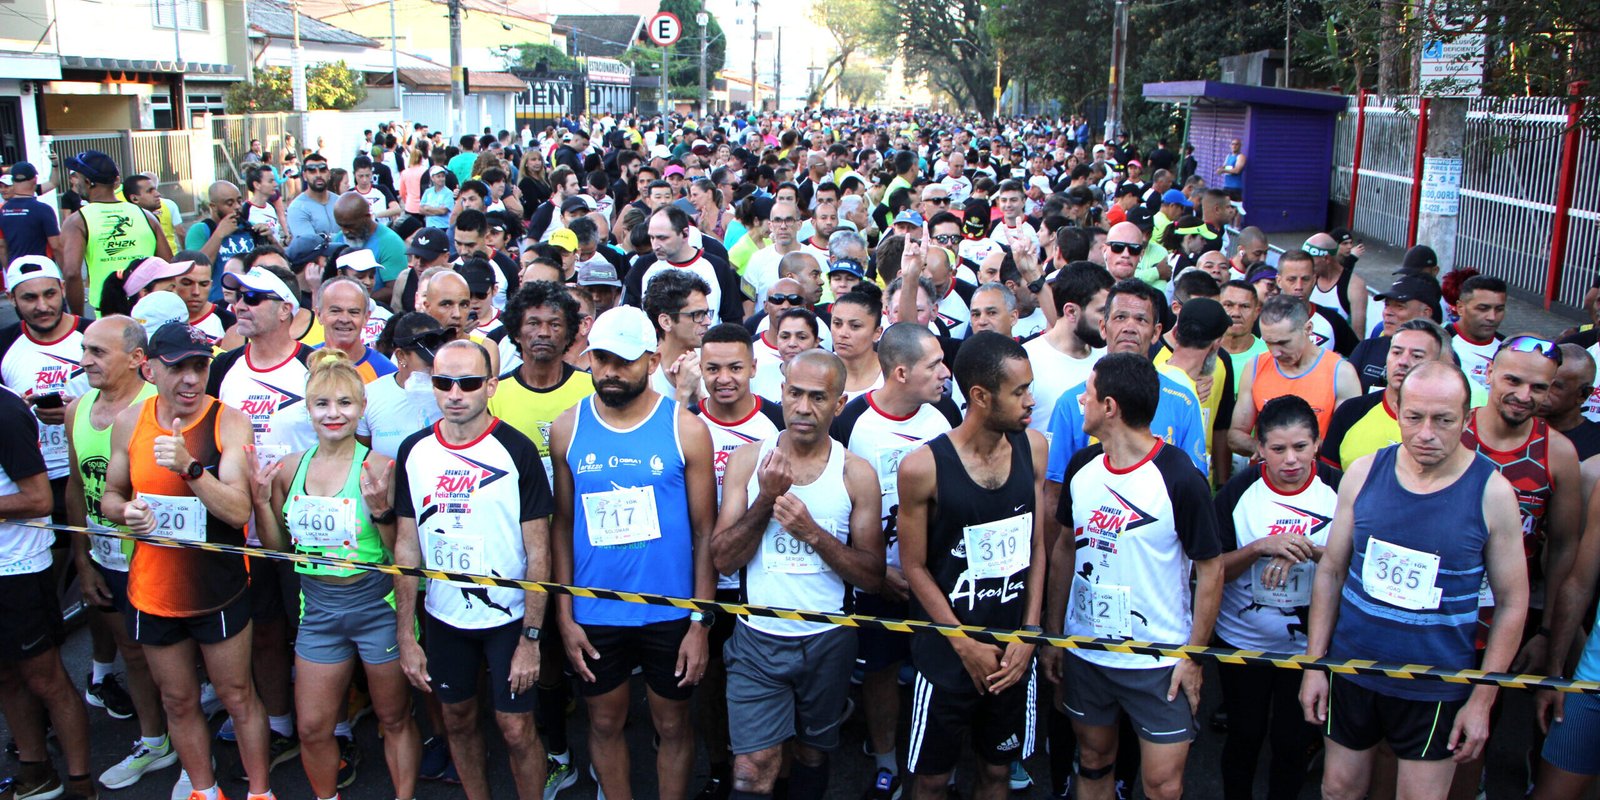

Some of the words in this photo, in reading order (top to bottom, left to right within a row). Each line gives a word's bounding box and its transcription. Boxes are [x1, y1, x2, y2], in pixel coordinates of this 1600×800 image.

[659, 20, 671, 39] E
[588, 60, 625, 74] ESTACIONAMENTO
[516, 86, 601, 106] MENO
[107, 239, 137, 249] R42K
[36, 370, 68, 386] RUN
[240, 399, 277, 415] RUN
[436, 474, 478, 493] RUN
[298, 513, 336, 532] 460
[596, 506, 635, 529] 717
[1088, 509, 1126, 530] RUN
[775, 536, 816, 555] 696
[980, 535, 1017, 562] 319
[434, 548, 471, 571] 616
[1376, 561, 1421, 590] 365
[1077, 592, 1111, 619] 312
[996, 742, 1021, 752] adidas
